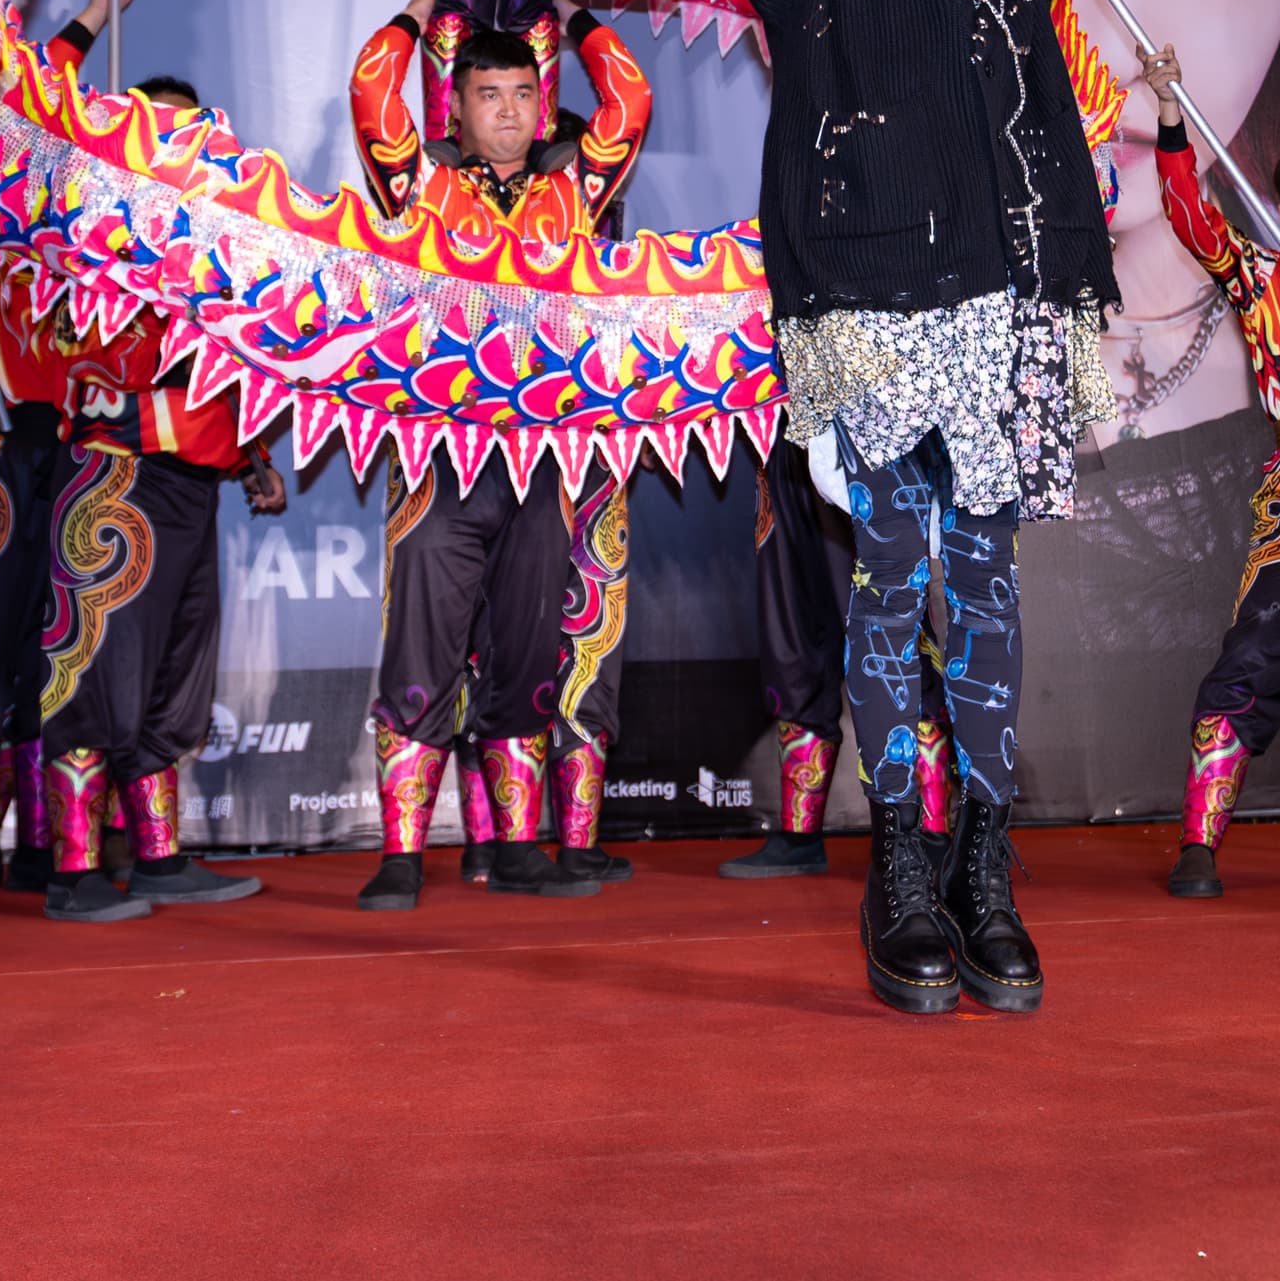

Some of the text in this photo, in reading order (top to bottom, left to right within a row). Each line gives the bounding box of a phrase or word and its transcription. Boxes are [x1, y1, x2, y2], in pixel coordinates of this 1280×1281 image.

[239, 524, 386, 601] AR
[236, 720, 313, 754] FUN
[603, 779, 677, 800] icketing
[716, 789, 753, 808] PLUS
[288, 790, 358, 814] Project
